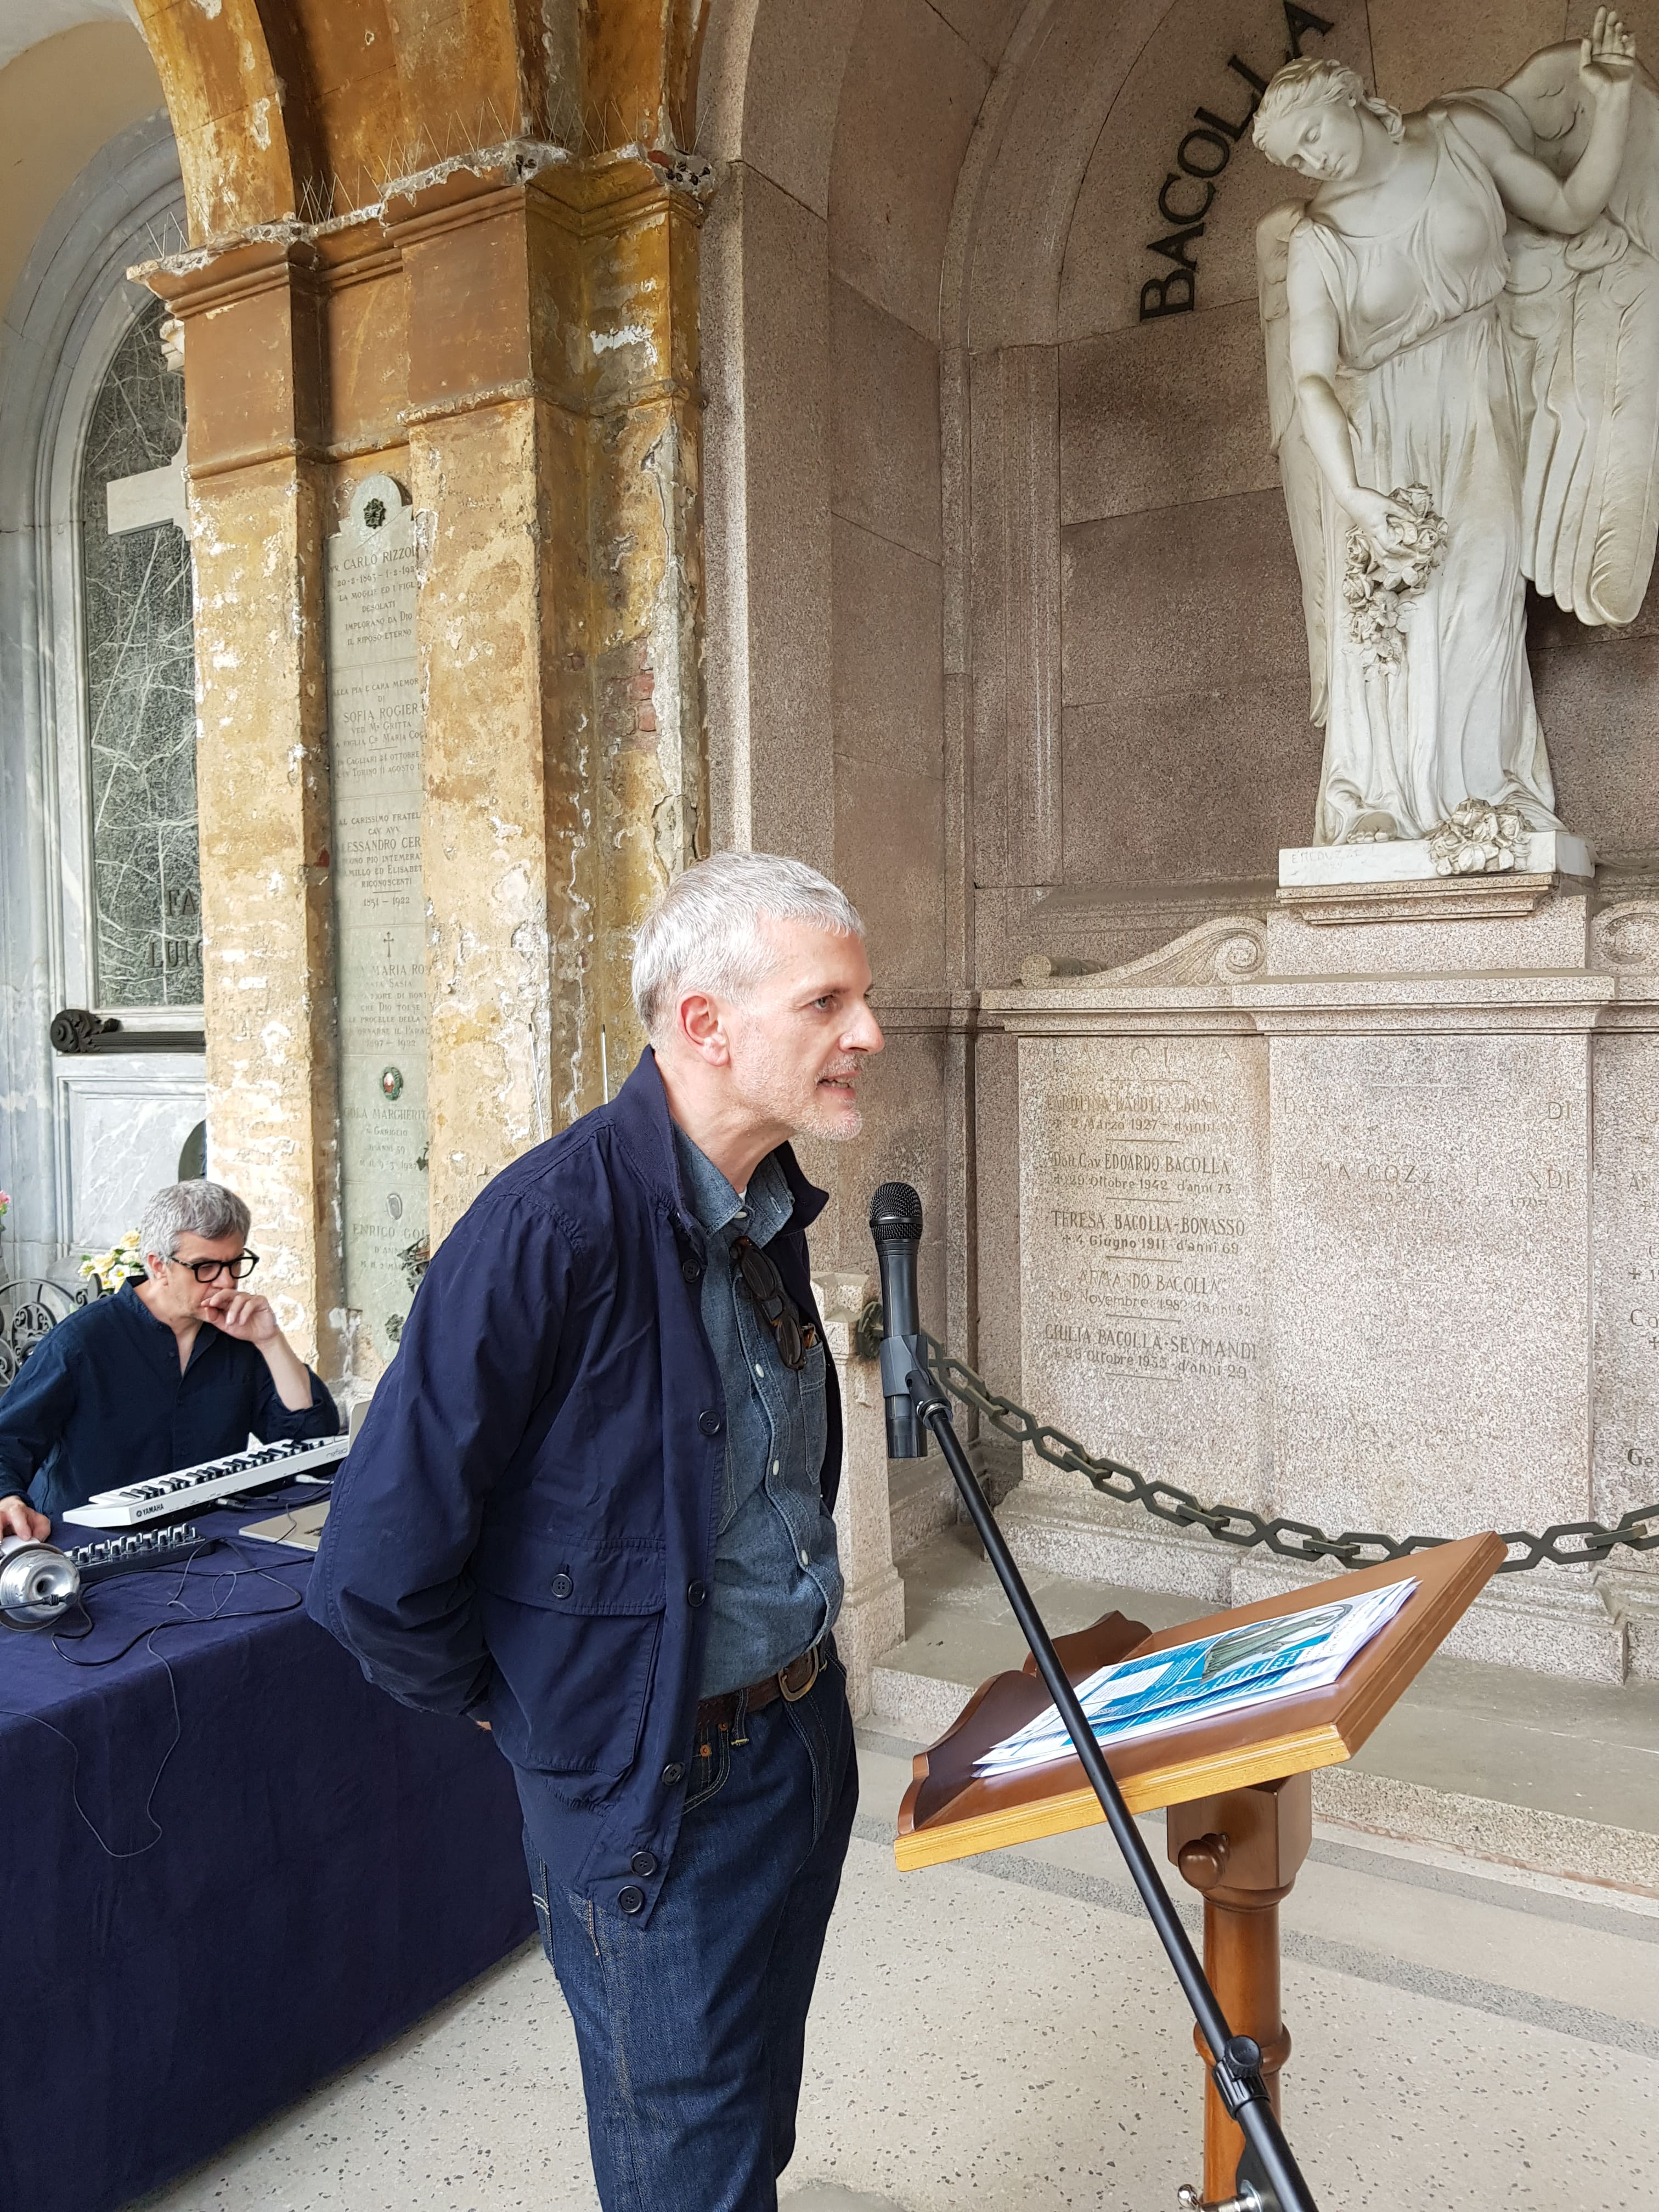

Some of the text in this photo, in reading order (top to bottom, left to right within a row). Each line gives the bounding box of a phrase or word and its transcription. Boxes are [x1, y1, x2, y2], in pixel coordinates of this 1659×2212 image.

[343, 554, 377, 571] CARLO
[351, 589, 377, 600] MOGLIE
[381, 586, 390, 594] ED
[362, 600, 396, 613] DESOLATI
[346, 618, 385, 631] IMPLORANO
[357, 634, 382, 645] RIPOSO
[385, 629, 411, 640] ETERNO
[352, 686, 362, 695] PIA
[343, 709, 375, 723] SOFIA
[390, 751, 420, 760] OTTOBRE
[388, 764, 415, 773] AGOSTO
[351, 815, 389, 825] CARISSIMO
[361, 878, 412, 888] RICONOSCENTI
[393, 897, 410, 907] 1922
[373, 964, 407, 975] MARIA
[1131, 1118, 1160, 1131] 1927
[1104, 1153, 1159, 1172] EDOARDO
[1165, 1155, 1229, 1175] BACOLLA
[1139, 1179, 1168, 1191] 1942
[1217, 1183, 1232, 1194] 73
[1050, 1210, 1105, 1230] TERESA
[353, 1224, 395, 1238] ENRICO
[1089, 1234, 1137, 1251] Giugno
[1142, 1238, 1166, 1250] 1911
[1079, 1269, 1220, 1295] ARMANDO BACOLLA
[1045, 1323, 1092, 1344] GIULIA
[143, 1503, 164, 1516] YAMAHA
